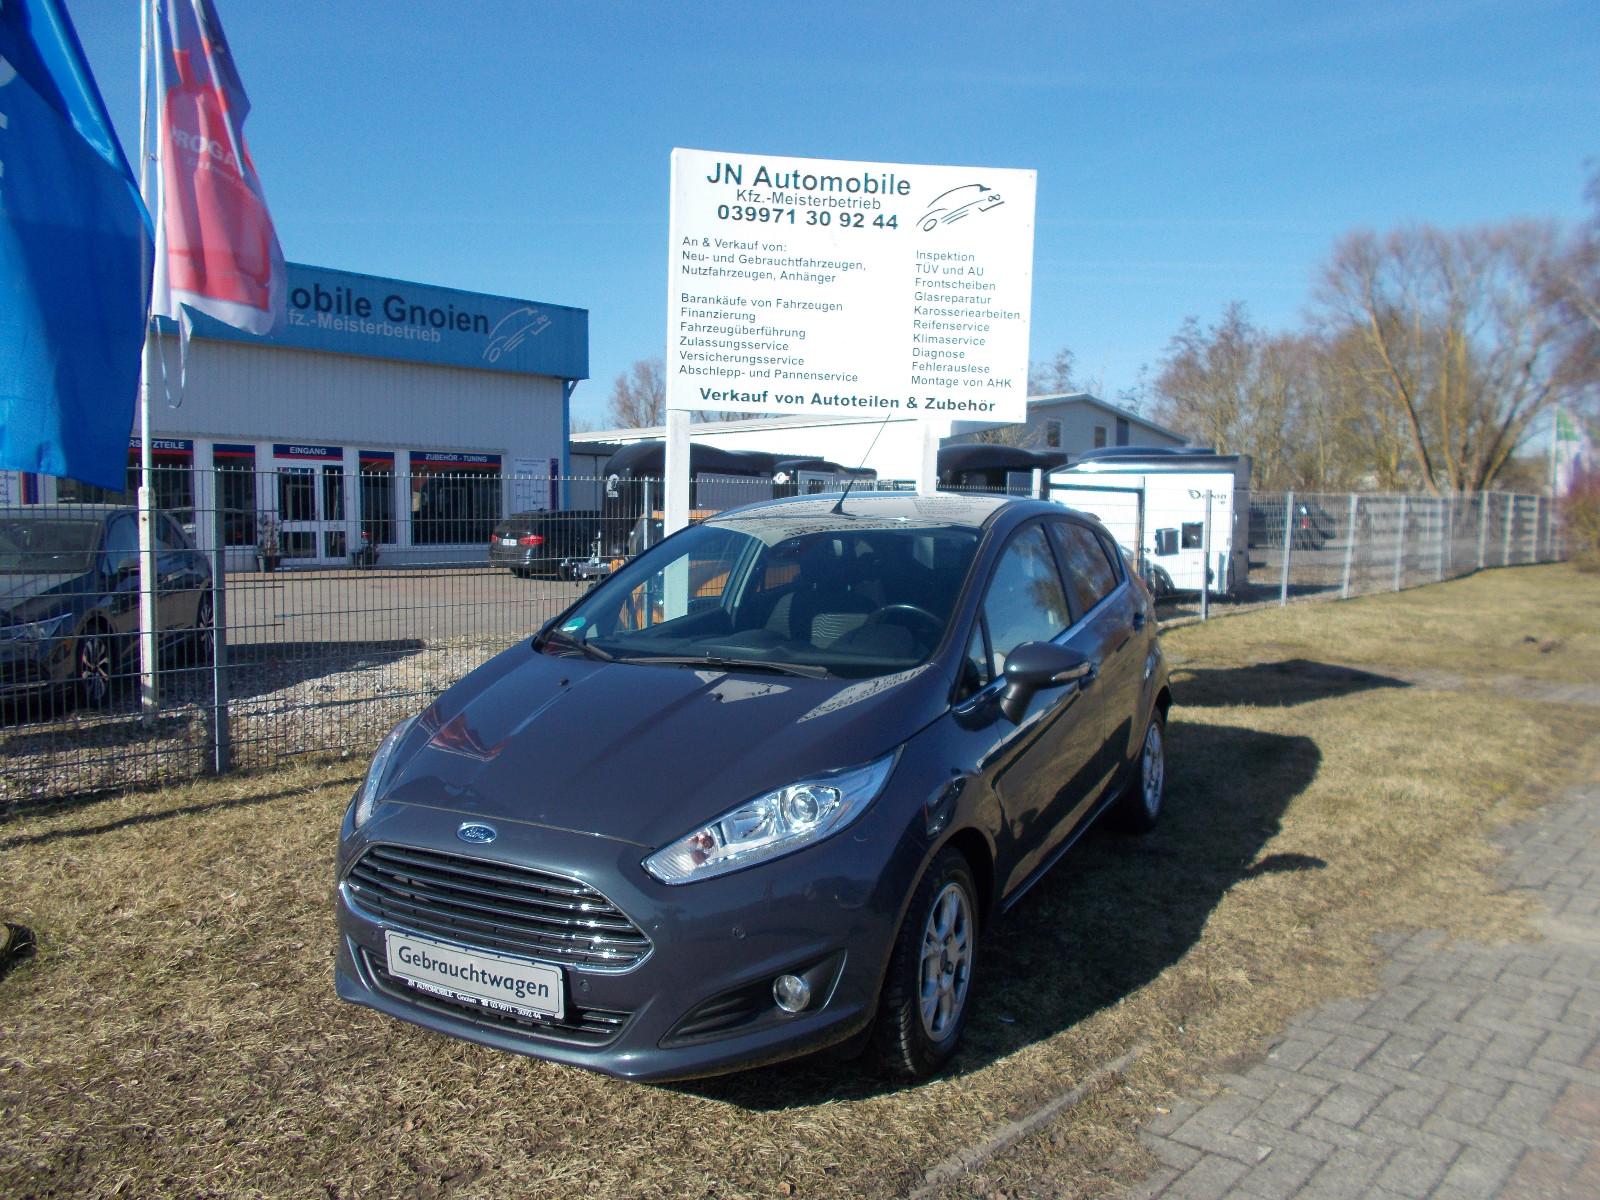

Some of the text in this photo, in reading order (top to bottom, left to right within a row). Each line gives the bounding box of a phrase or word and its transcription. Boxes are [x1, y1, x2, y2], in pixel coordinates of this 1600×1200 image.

[706, 162, 911, 196] JN Automobile
[736, 188, 881, 210] Kfz.-Meisterbetrieb
[717, 204, 899, 230] 039971 30 92 44
[682, 236, 787, 252] An & Verkauf von:
[682, 250, 867, 272] Neu- und Gebrauchtfahrzeugen,
[916, 249, 975, 262] Inspektion
[682, 265, 836, 285] Nutzfahrzeugen, Anhänger
[915, 261, 984, 277] TÜV und AU
[915, 277, 996, 291] Frontscheiben
[681, 292, 843, 312] Barankäufe von Fahrzeugen
[914, 291, 992, 305] Glasreparatur
[290, 283, 489, 334] obile Gnoien
[680, 307, 756, 323] Finanzierung
[914, 305, 1020, 320] Karosseriearbeiten
[288, 308, 441, 343] fz.-Meisterbetrieb
[680, 321, 806, 340] Fahrzeugüberführung
[913, 319, 990, 332] Reifenservice
[679, 336, 789, 351] Zulassungsservice
[913, 333, 986, 346] Klimaservice
[679, 350, 805, 366] Versicherungsservice
[912, 347, 965, 360] Diagnose
[679, 364, 858, 382] Abschlepp- und Pannenservice
[911, 361, 990, 374] Fehlerauslese
[911, 375, 1012, 389] Montage von AHK
[700, 387, 996, 412] Verkauf von Autoteilen & Zubehör
[289, 446, 327, 456] EINGANG
[425, 452, 458, 463] ZUBEHÖR
[463, 454, 488, 463] TUNING
[398, 945, 549, 999] Gebrauchtwagen
